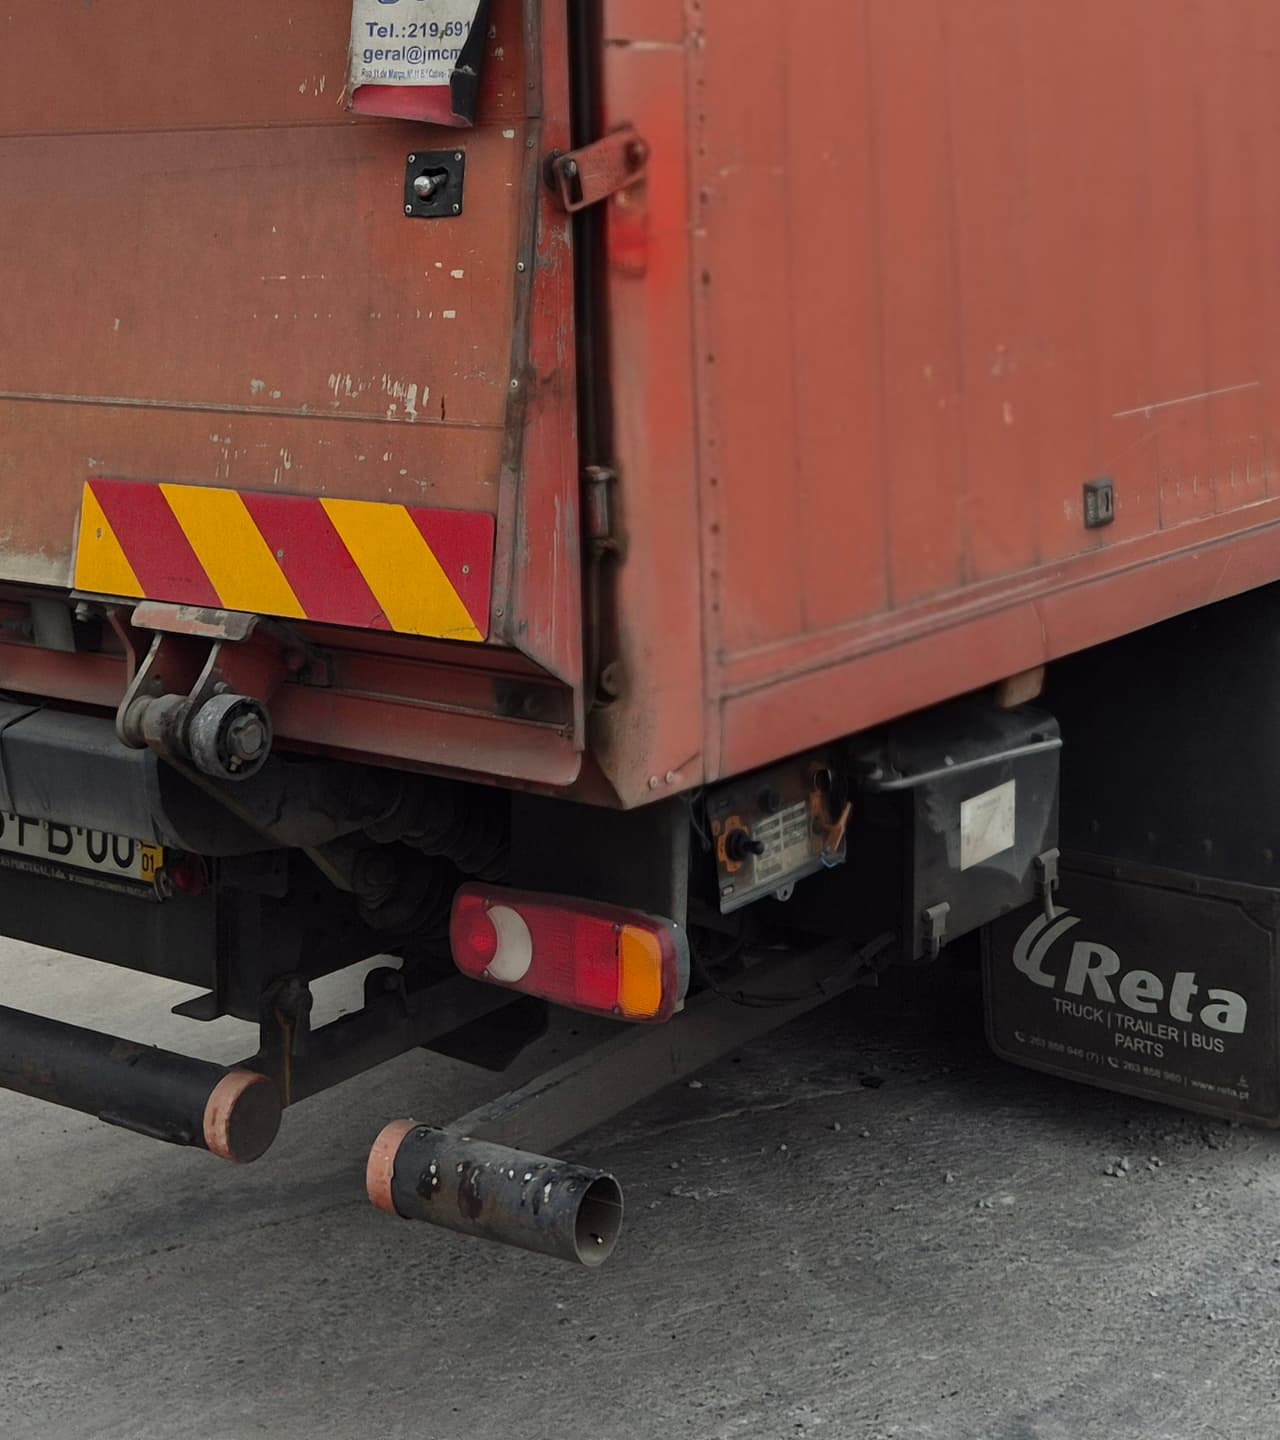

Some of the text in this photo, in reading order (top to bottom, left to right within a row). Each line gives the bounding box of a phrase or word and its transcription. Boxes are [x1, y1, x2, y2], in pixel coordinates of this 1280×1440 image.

[1064, 941, 1248, 1033] Reta
[1053, 997, 1225, 1053] TRUCK TRAILER BUS
[1115, 1032, 1164, 1058] PARTS
